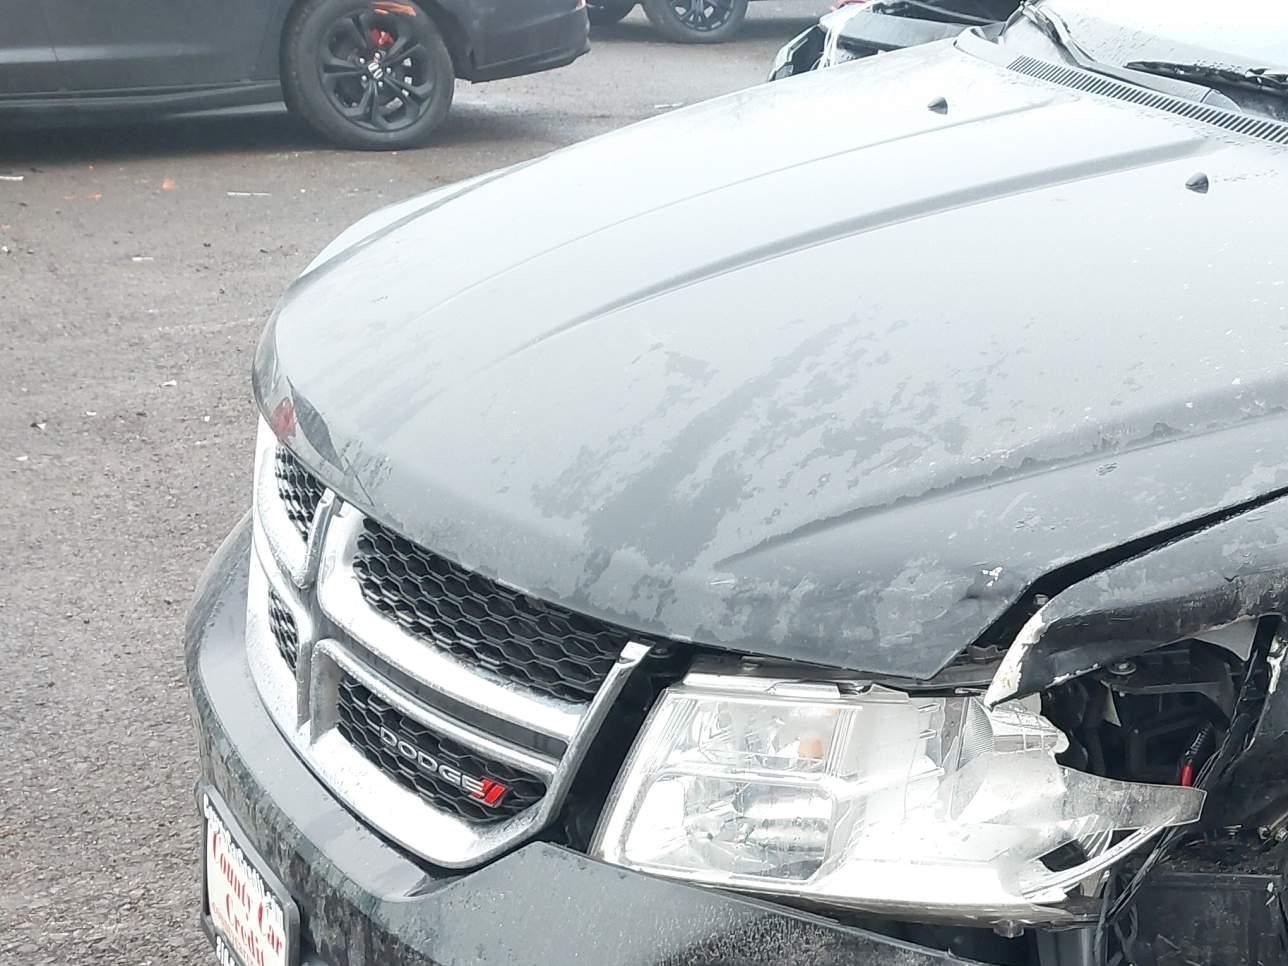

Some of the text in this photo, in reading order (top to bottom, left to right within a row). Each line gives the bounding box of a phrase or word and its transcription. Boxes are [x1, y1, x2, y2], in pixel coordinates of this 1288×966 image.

[380, 726, 485, 798] DODGE
[212, 831, 284, 956] County Car
